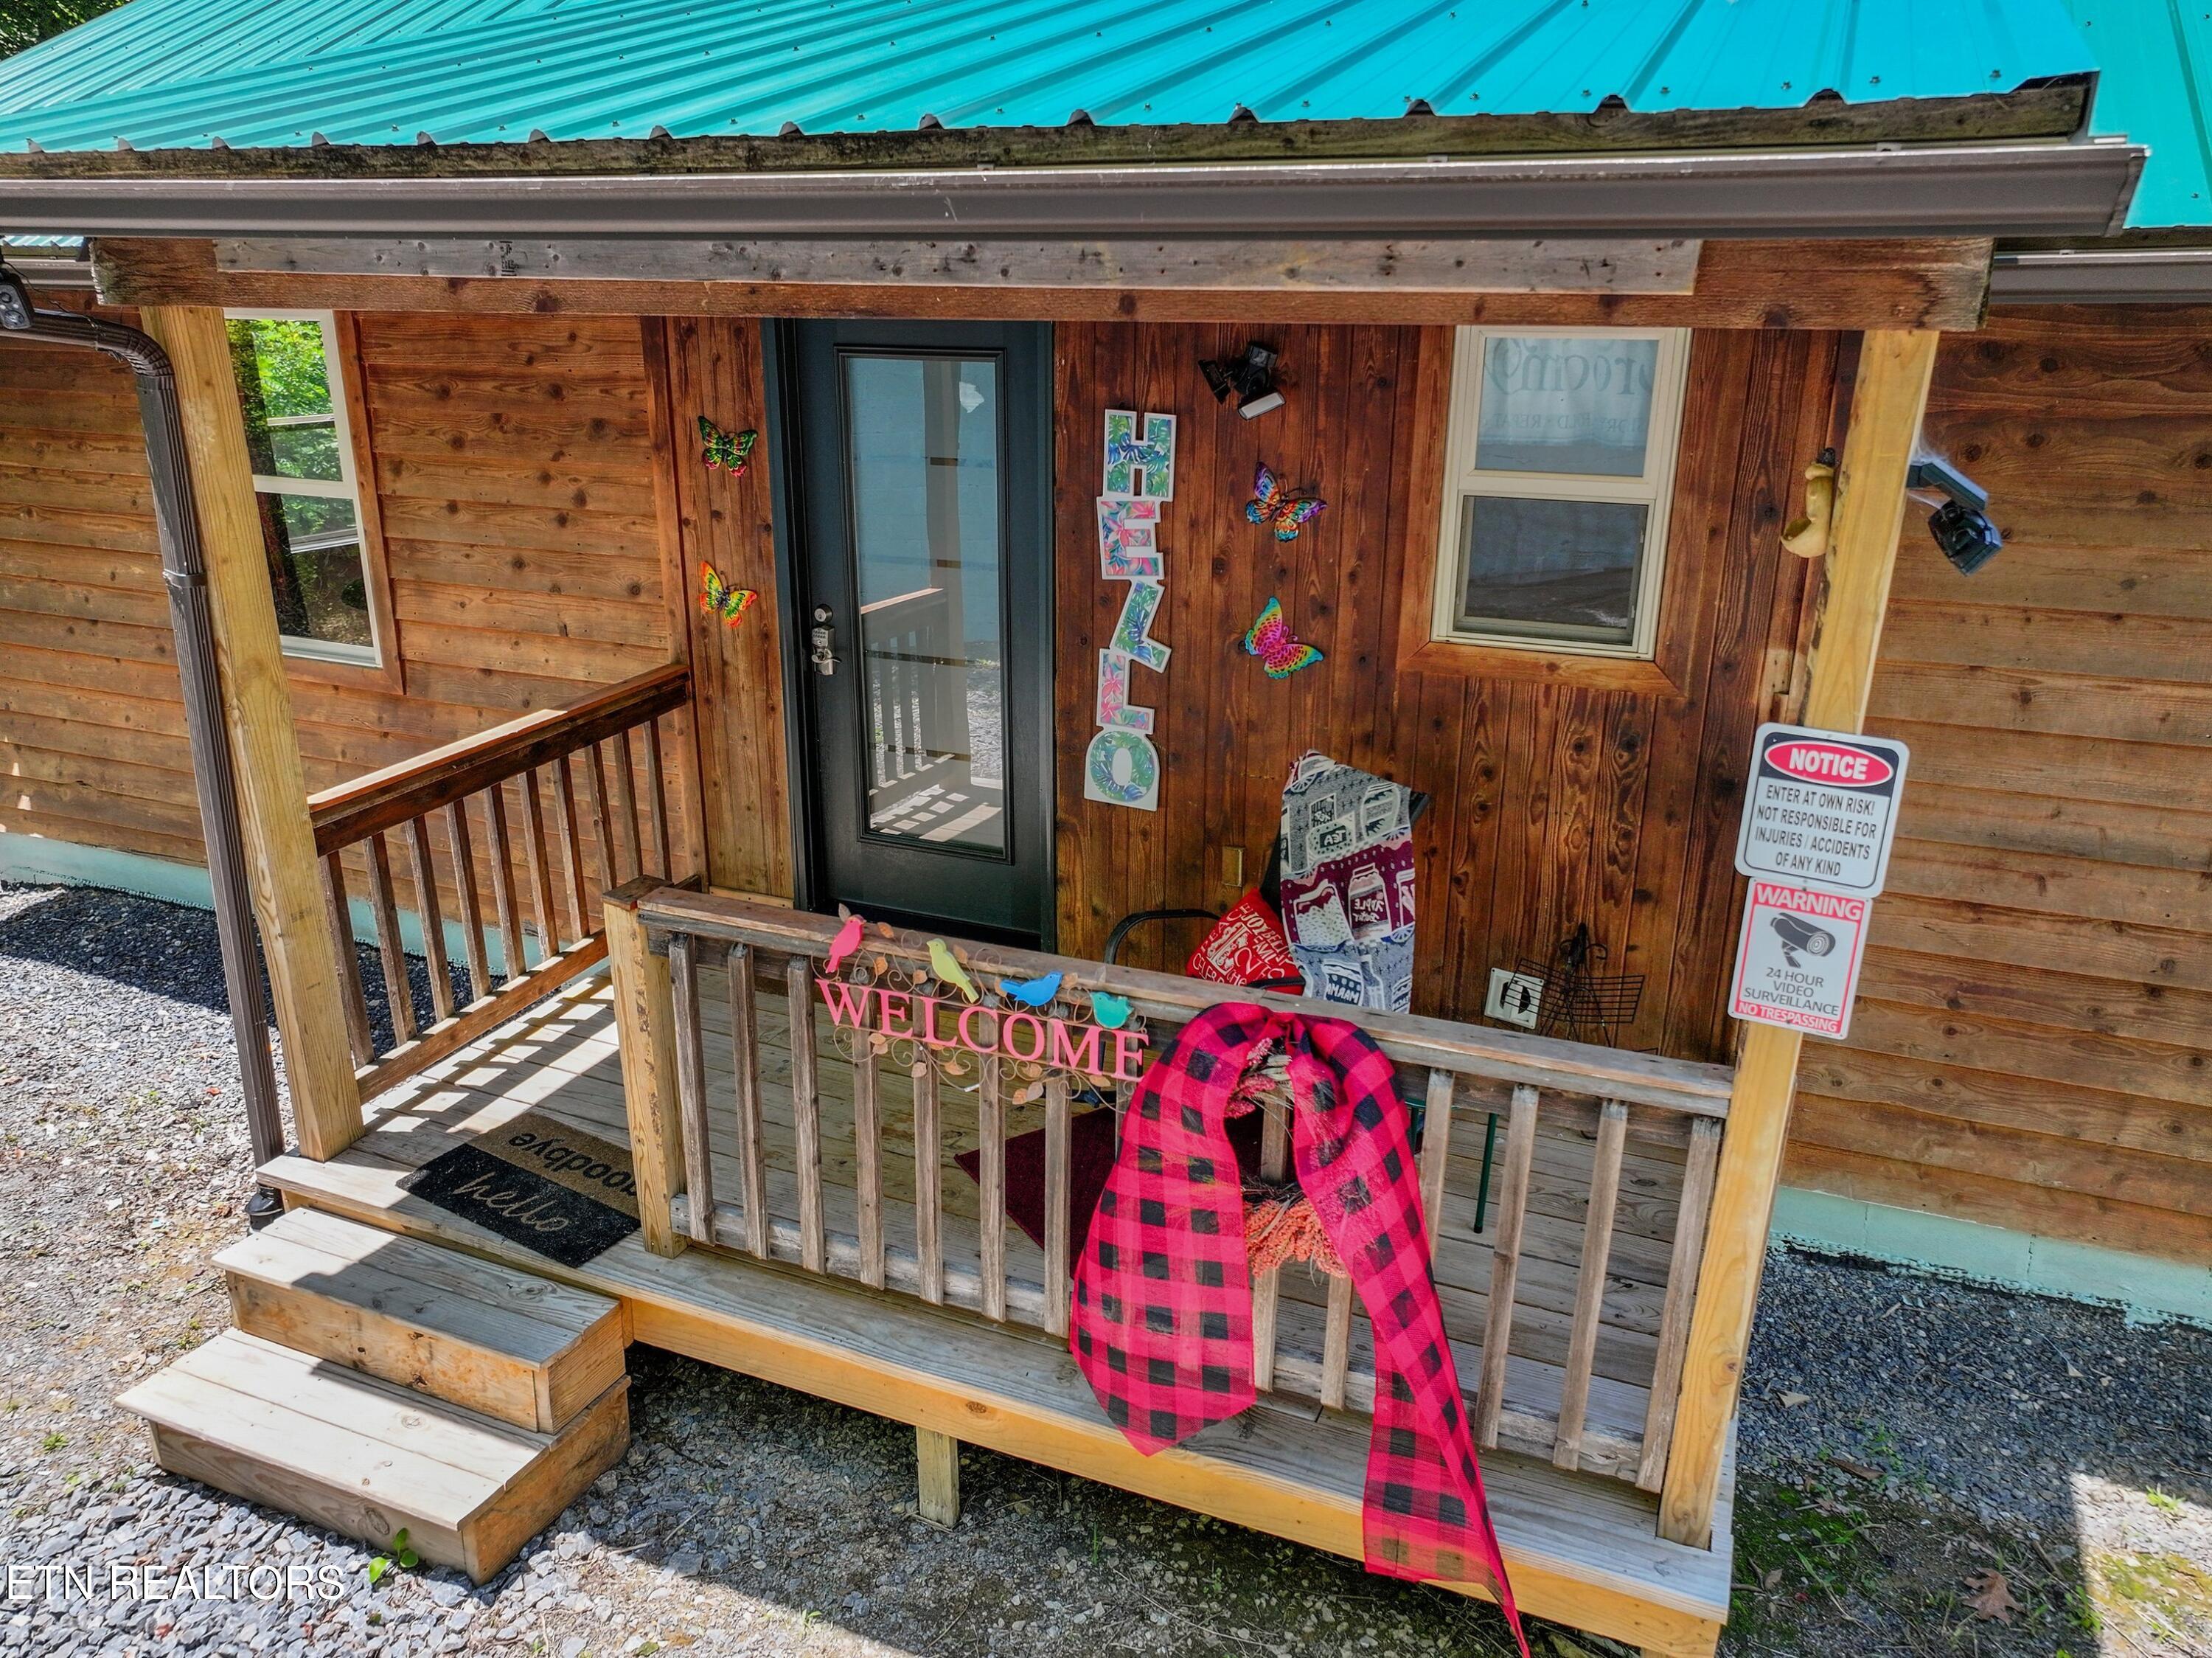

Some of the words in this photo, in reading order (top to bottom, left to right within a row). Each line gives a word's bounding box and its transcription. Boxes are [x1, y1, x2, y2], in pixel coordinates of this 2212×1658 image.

[1084, 409, 1177, 811] HELLO
[1789, 747, 1870, 780] NOTICE
[1766, 785, 1801, 804] ENTER
[1802, 791, 1817, 806] AT
[1819, 794, 1843, 811] OWN
[1846, 797, 1876, 816] RISK!
[1756, 805, 1778, 825] NOT
[1780, 809, 1853, 835] RESPONSIBLE
[1854, 822, 1877, 839] FOR
[1755, 826, 1803, 848] INJURIES
[1810, 836, 1870, 860] ACCIDENTS
[1775, 852, 1790, 867] OF
[1790, 854, 1813, 871] ANY
[1814, 859, 1841, 876] KIND
[1756, 884, 1863, 920] WARNING
[1766, 967, 1781, 978] 24
[1784, 971, 1824, 988] HOUR
[1773, 981, 1814, 998] VIDEO
[1739, 1002, 1759, 1016] NO
[1760, 1006, 1838, 1032] TRESPASSING
[1745, 987, 1840, 1016] SURVEILLANCE
[815, 978, 1150, 1083] WELCOME
[452, 1170, 568, 1232] hello
